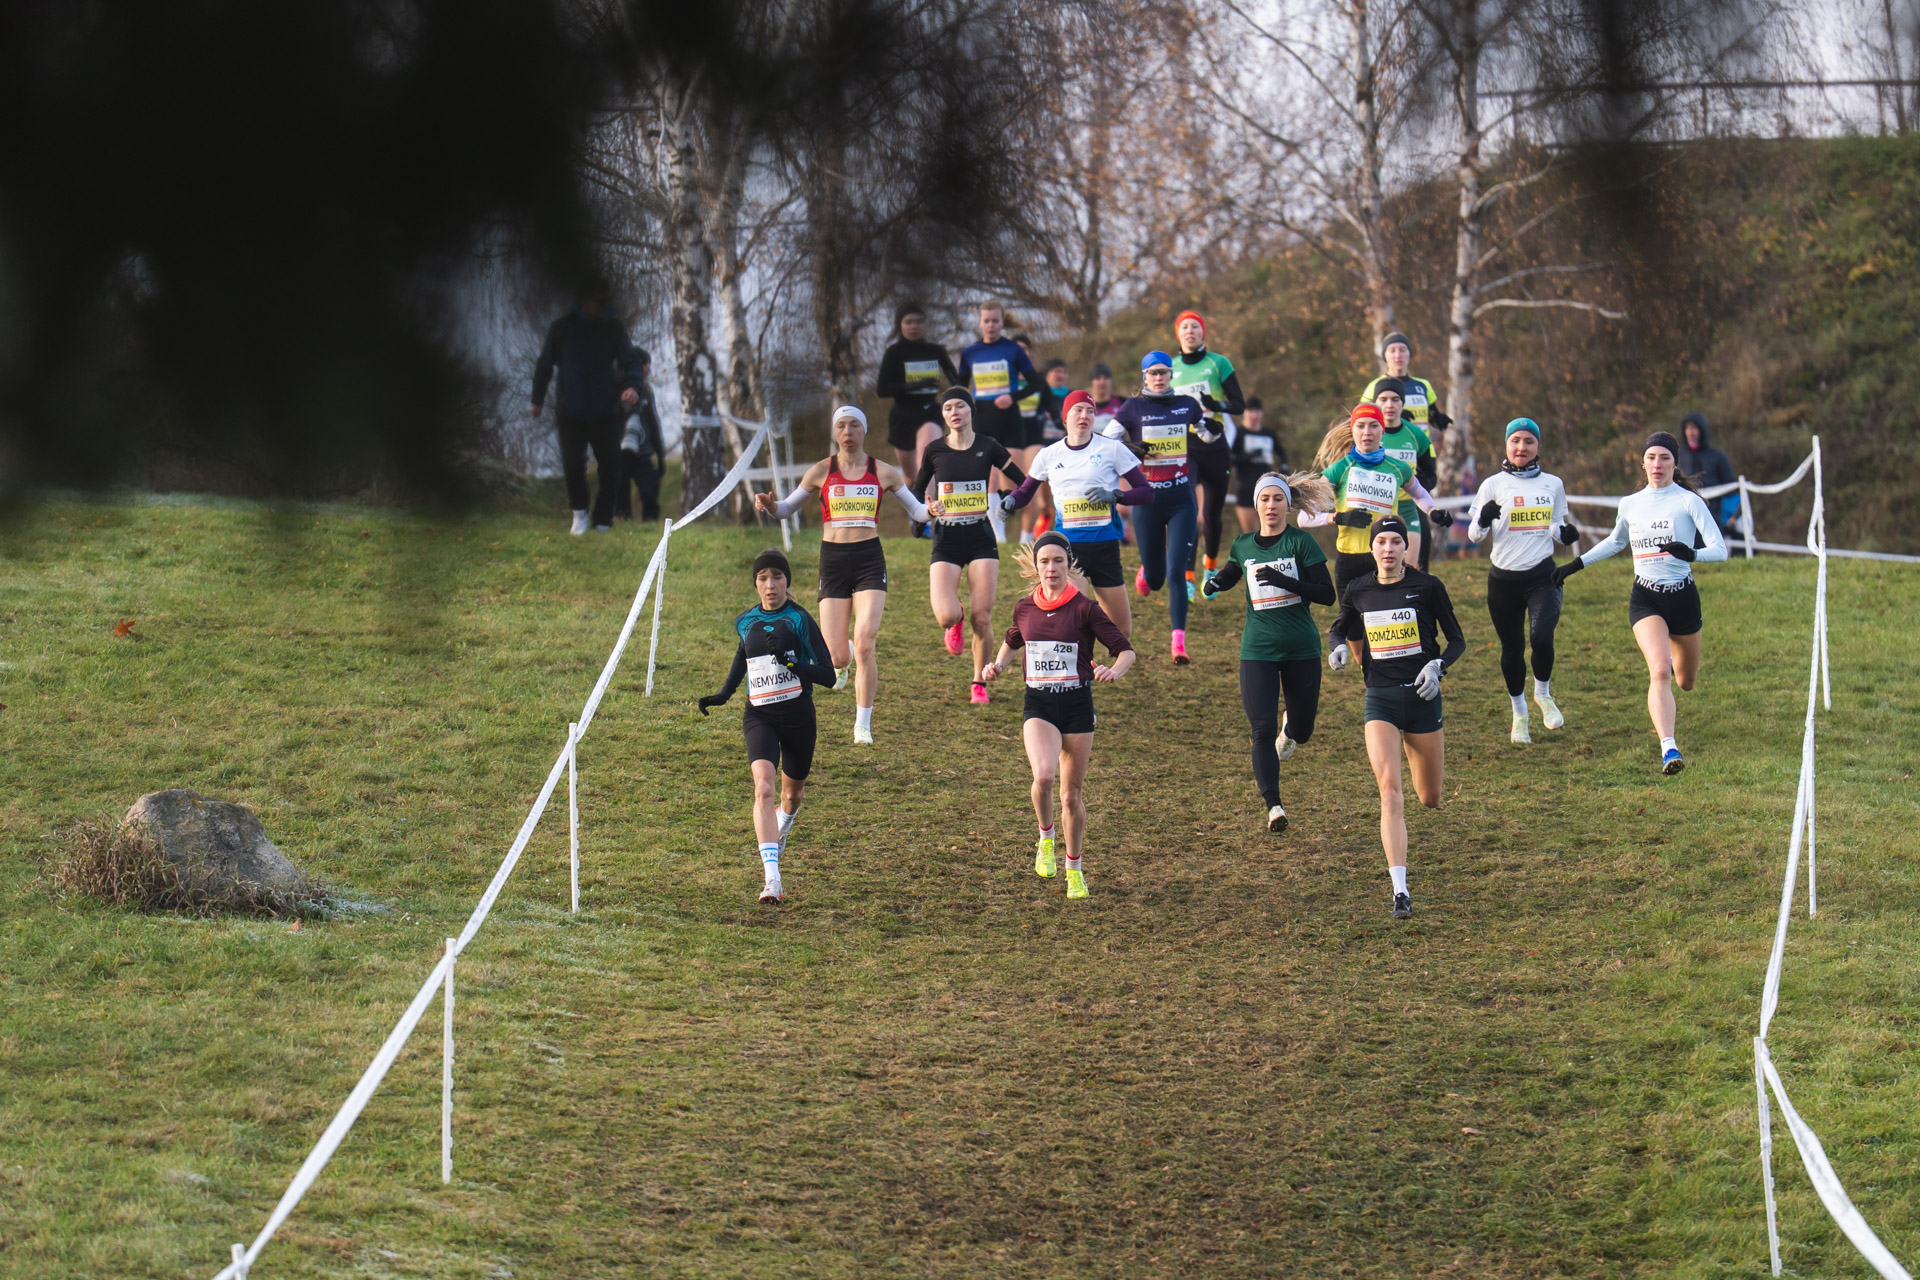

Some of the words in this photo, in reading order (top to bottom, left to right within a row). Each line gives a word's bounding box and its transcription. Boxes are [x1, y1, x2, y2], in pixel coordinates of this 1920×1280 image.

[1190, 384, 1206, 393] 378
[1168, 427, 1184, 435] 294
[1150, 441, 1181, 453] WĄSIK
[1399, 451, 1414, 460] 377
[1375, 474, 1393, 484] 374
[856, 486, 875, 496] 202
[965, 483, 982, 492] 133
[1348, 482, 1394, 500] BAŃKOWSKA
[1535, 496, 1551, 505] 154
[831, 500, 876, 513] NAPIÓRKOWSKA
[1651, 520, 1669, 530] 442
[1274, 562, 1293, 572] 804
[1636, 576, 1660, 592] NIKE
[1662, 580, 1685, 594] PRO
[1391, 610, 1411, 622] 440
[1368, 627, 1417, 642] DOMŻALSKA
[1053, 644, 1073, 653] 428
[1035, 660, 1068, 671] BREZA
[750, 671, 798, 689] NIEMYJSKA
[776, 694, 788, 702] 2025
